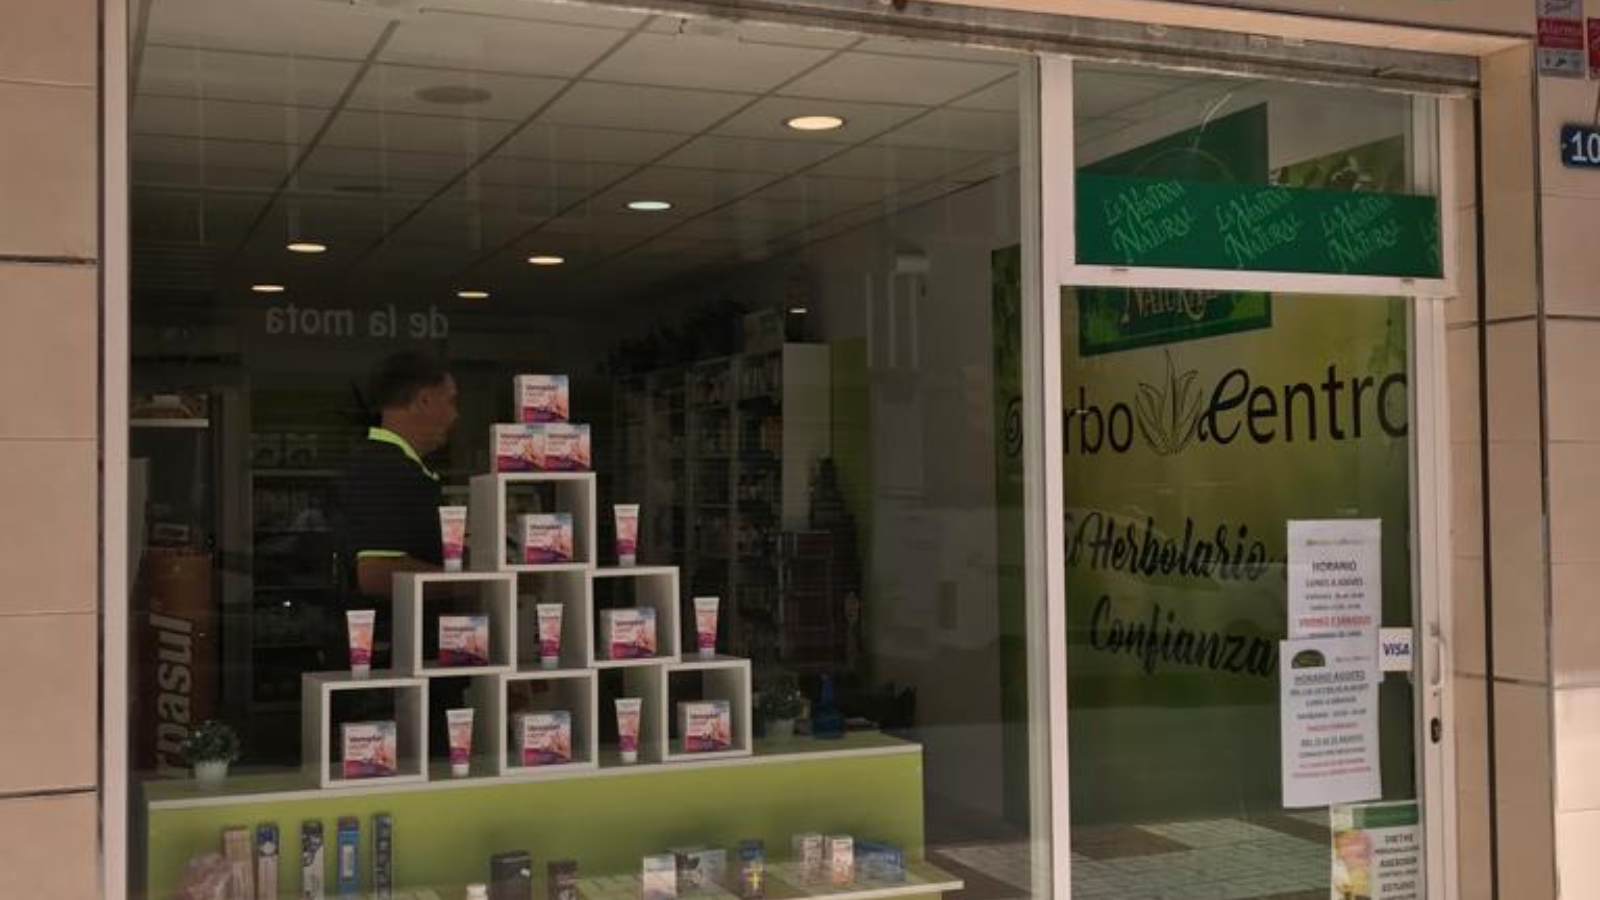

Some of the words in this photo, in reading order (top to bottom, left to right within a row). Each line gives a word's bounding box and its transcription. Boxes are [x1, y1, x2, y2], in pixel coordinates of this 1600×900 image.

[1073, 511, 1268, 582] Herbolario
[1090, 595, 1276, 677] Confianza
[1383, 643, 1409, 656] VISA
